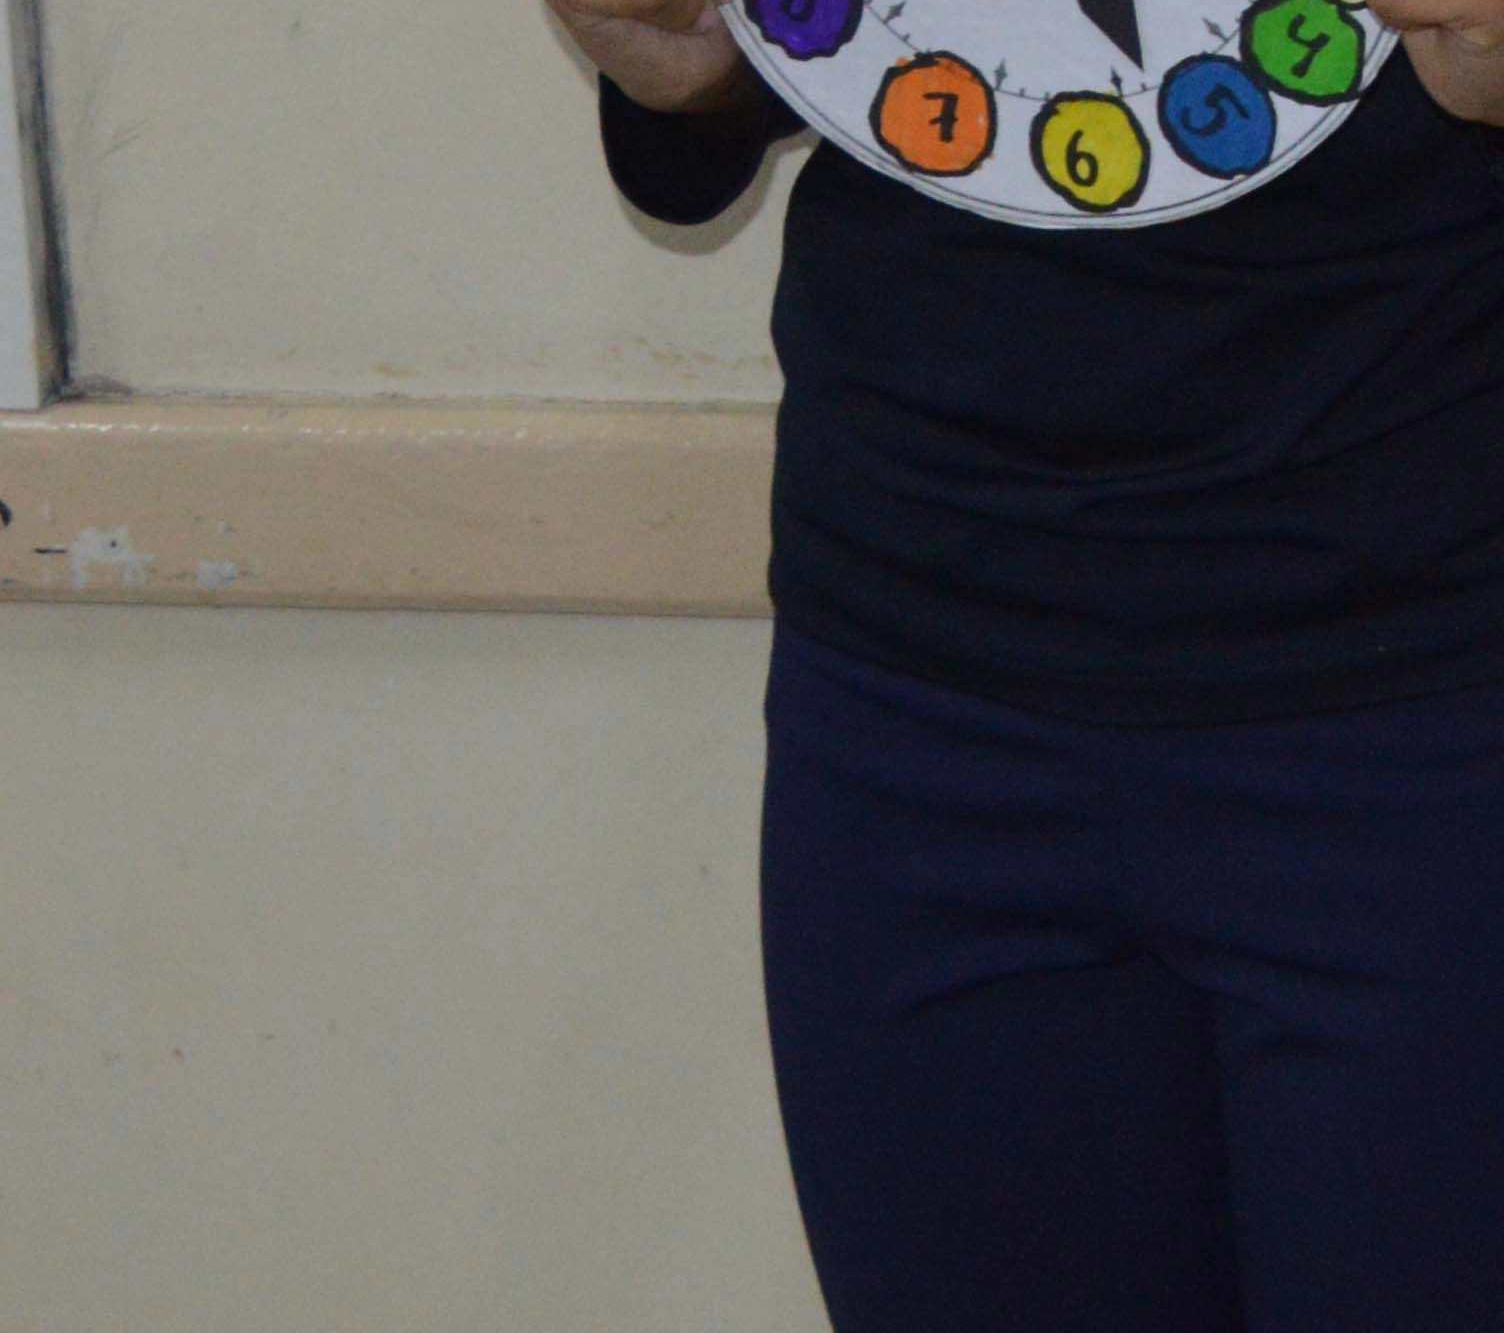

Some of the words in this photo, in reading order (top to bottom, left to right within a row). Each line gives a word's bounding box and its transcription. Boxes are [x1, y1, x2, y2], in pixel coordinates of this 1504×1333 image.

[1286, 13, 1331, 79] 4
[924, 91, 959, 143] 7
[1180, 84, 1249, 138] 5
[1065, 129, 1099, 188] 6
